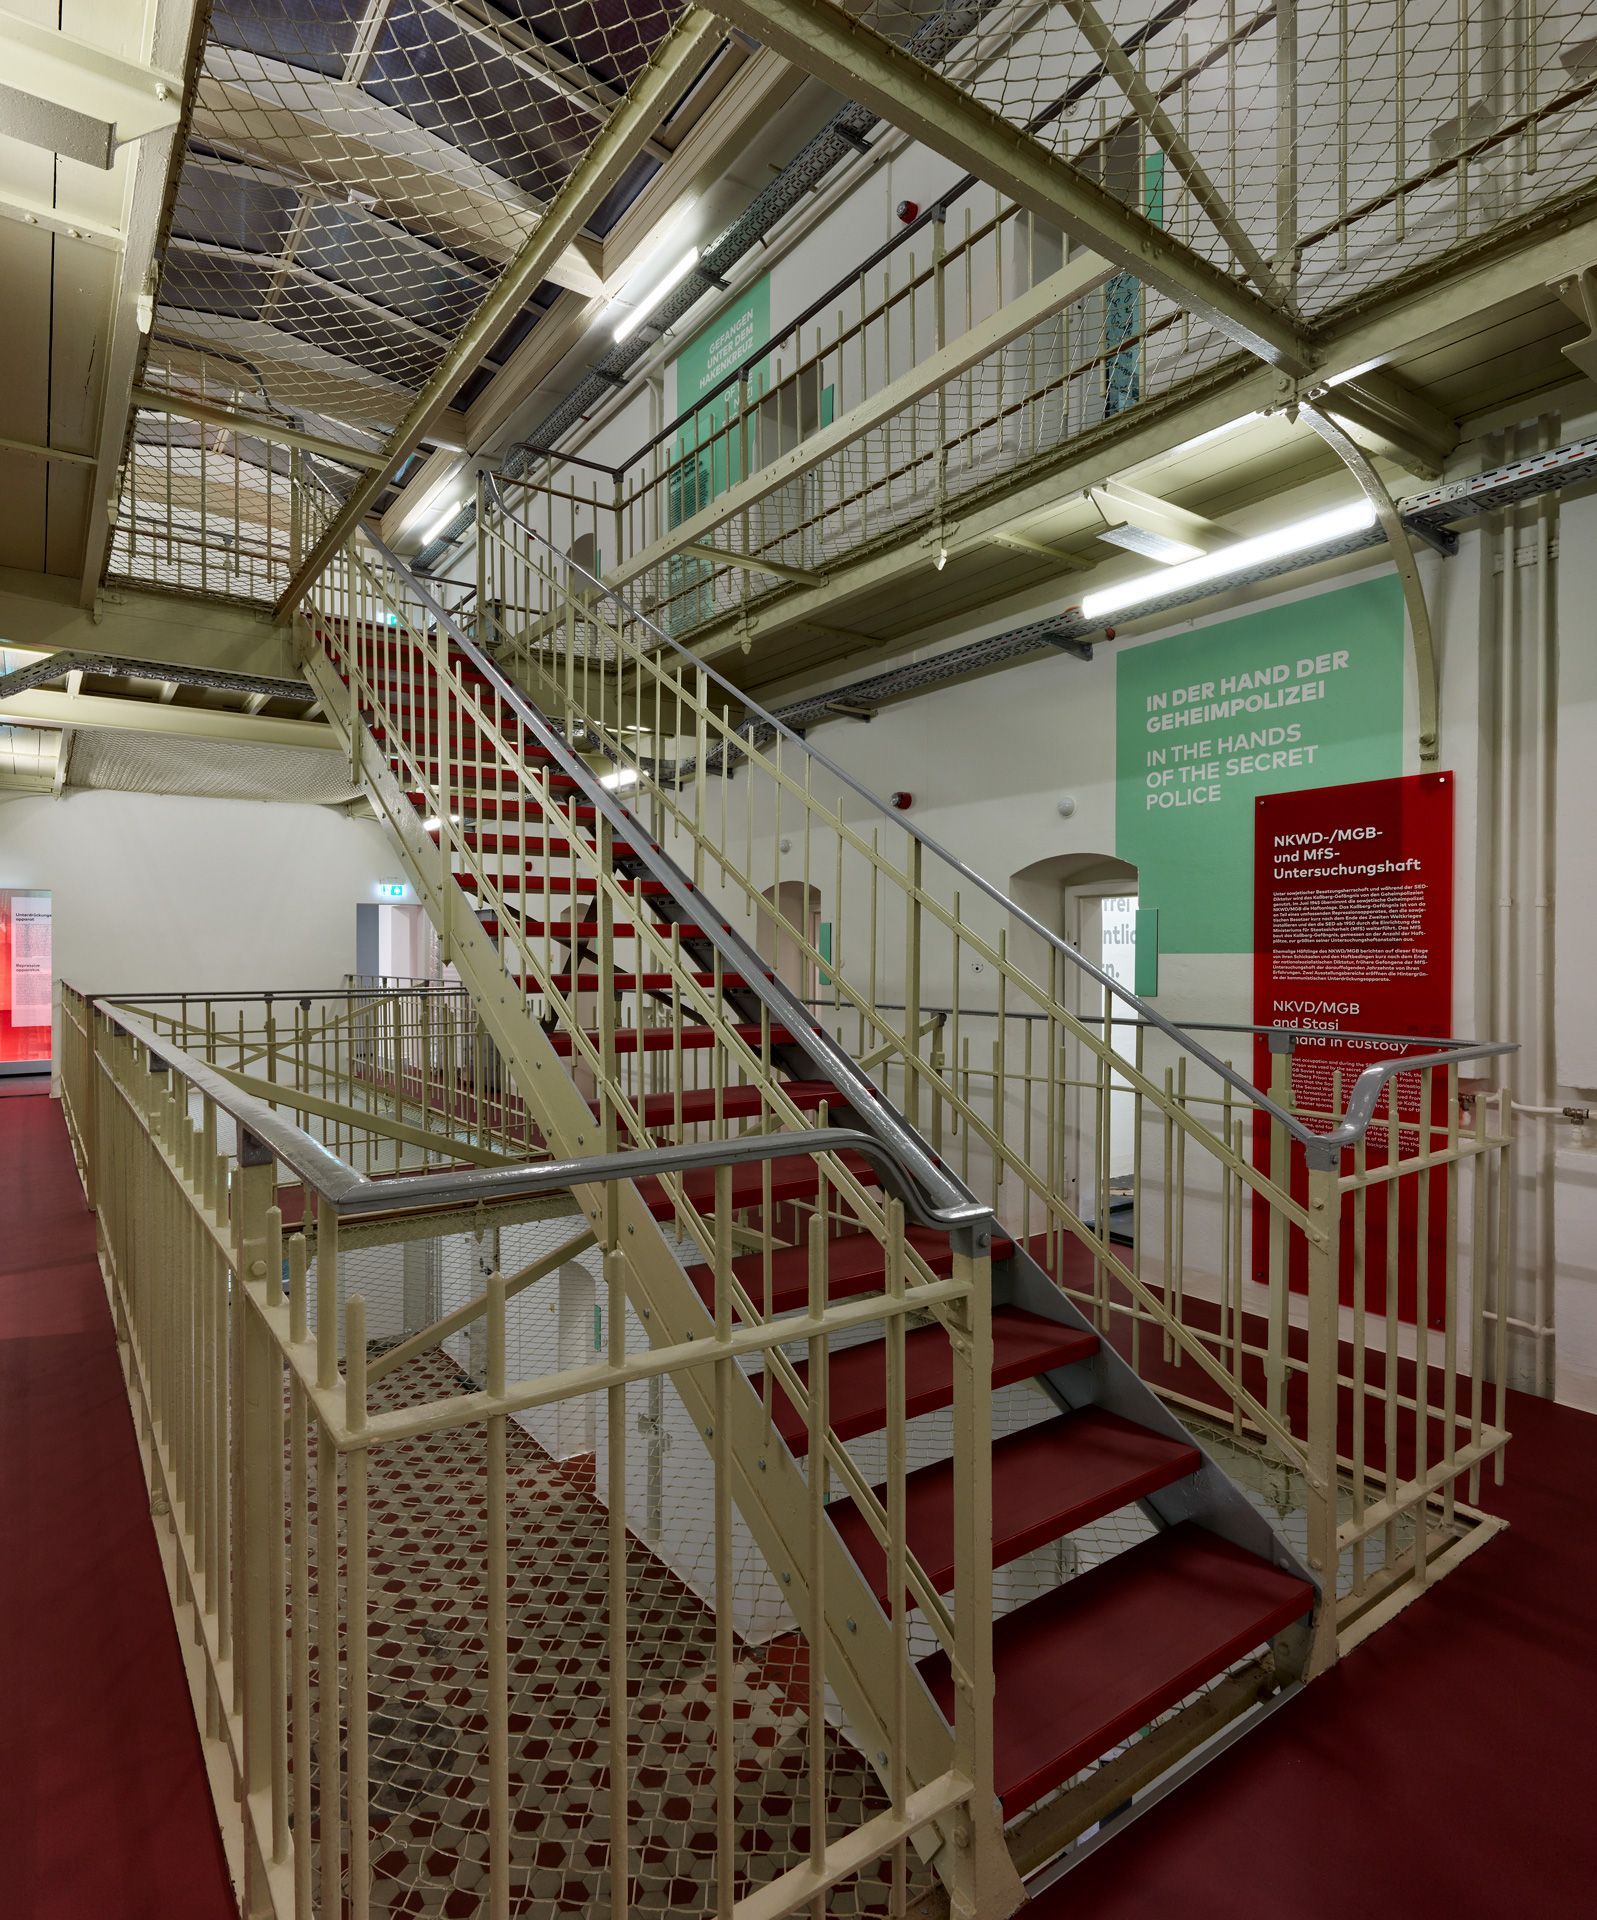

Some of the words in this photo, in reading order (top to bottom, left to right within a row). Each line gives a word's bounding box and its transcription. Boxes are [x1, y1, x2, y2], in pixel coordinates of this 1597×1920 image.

[708, 341, 733, 368] UNTER
[735, 323, 753, 346] DEM
[710, 308, 753, 354] GEFANGEN
[700, 336, 753, 389] HAKENKREUZ
[1147, 696, 1167, 712] IN
[1172, 682, 1215, 706] DER
[1220, 665, 1290, 696] HAND
[1296, 650, 1350, 678] DER
[1146, 680, 1325, 733] GEHEIMPOLIZEI
[1147, 750, 1166, 768] IN
[1171, 740, 1211, 761] THE
[1218, 723, 1302, 755] HANDS
[1146, 770, 1174, 789] OF
[1178, 762, 1219, 784] THE
[1226, 744, 1318, 776] SECRET
[1146, 784, 1221, 810] POLICE
[1274, 827, 1383, 847] NKWD-/MGB-
[1273, 858, 1421, 879] Untersuchungshaft
[1274, 850, 1299, 863] und
[1304, 847, 1340, 861] MfS-
[1273, 1000, 1360, 1014] NKVD/MGB
[1273, 1016, 1298, 1028] and
[1303, 1018, 1339, 1030] Stasi
[1347, 1040, 1408, 1054] custody
